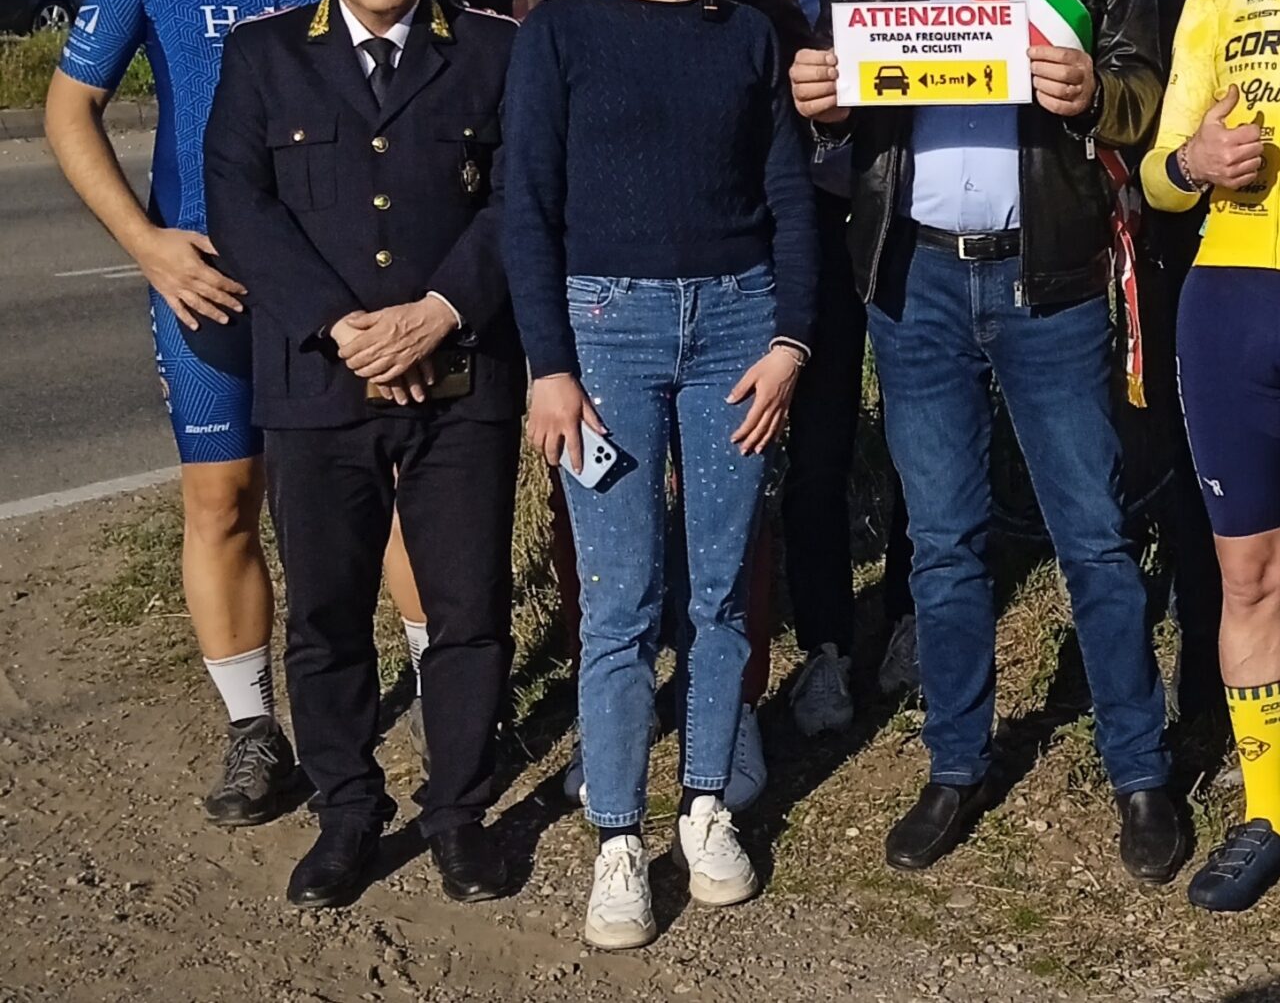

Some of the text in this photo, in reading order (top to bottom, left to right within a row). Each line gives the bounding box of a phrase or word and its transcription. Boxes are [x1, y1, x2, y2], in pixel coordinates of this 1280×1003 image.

[848, 5, 1012, 28] ATTENZIONE
[869, 31, 993, 43] STRADA FREQUENTATA
[902, 44, 962, 54] DA CICLISTI
[929, 74, 965, 86] 1,5 mt
[184, 421, 230, 434] Santini
